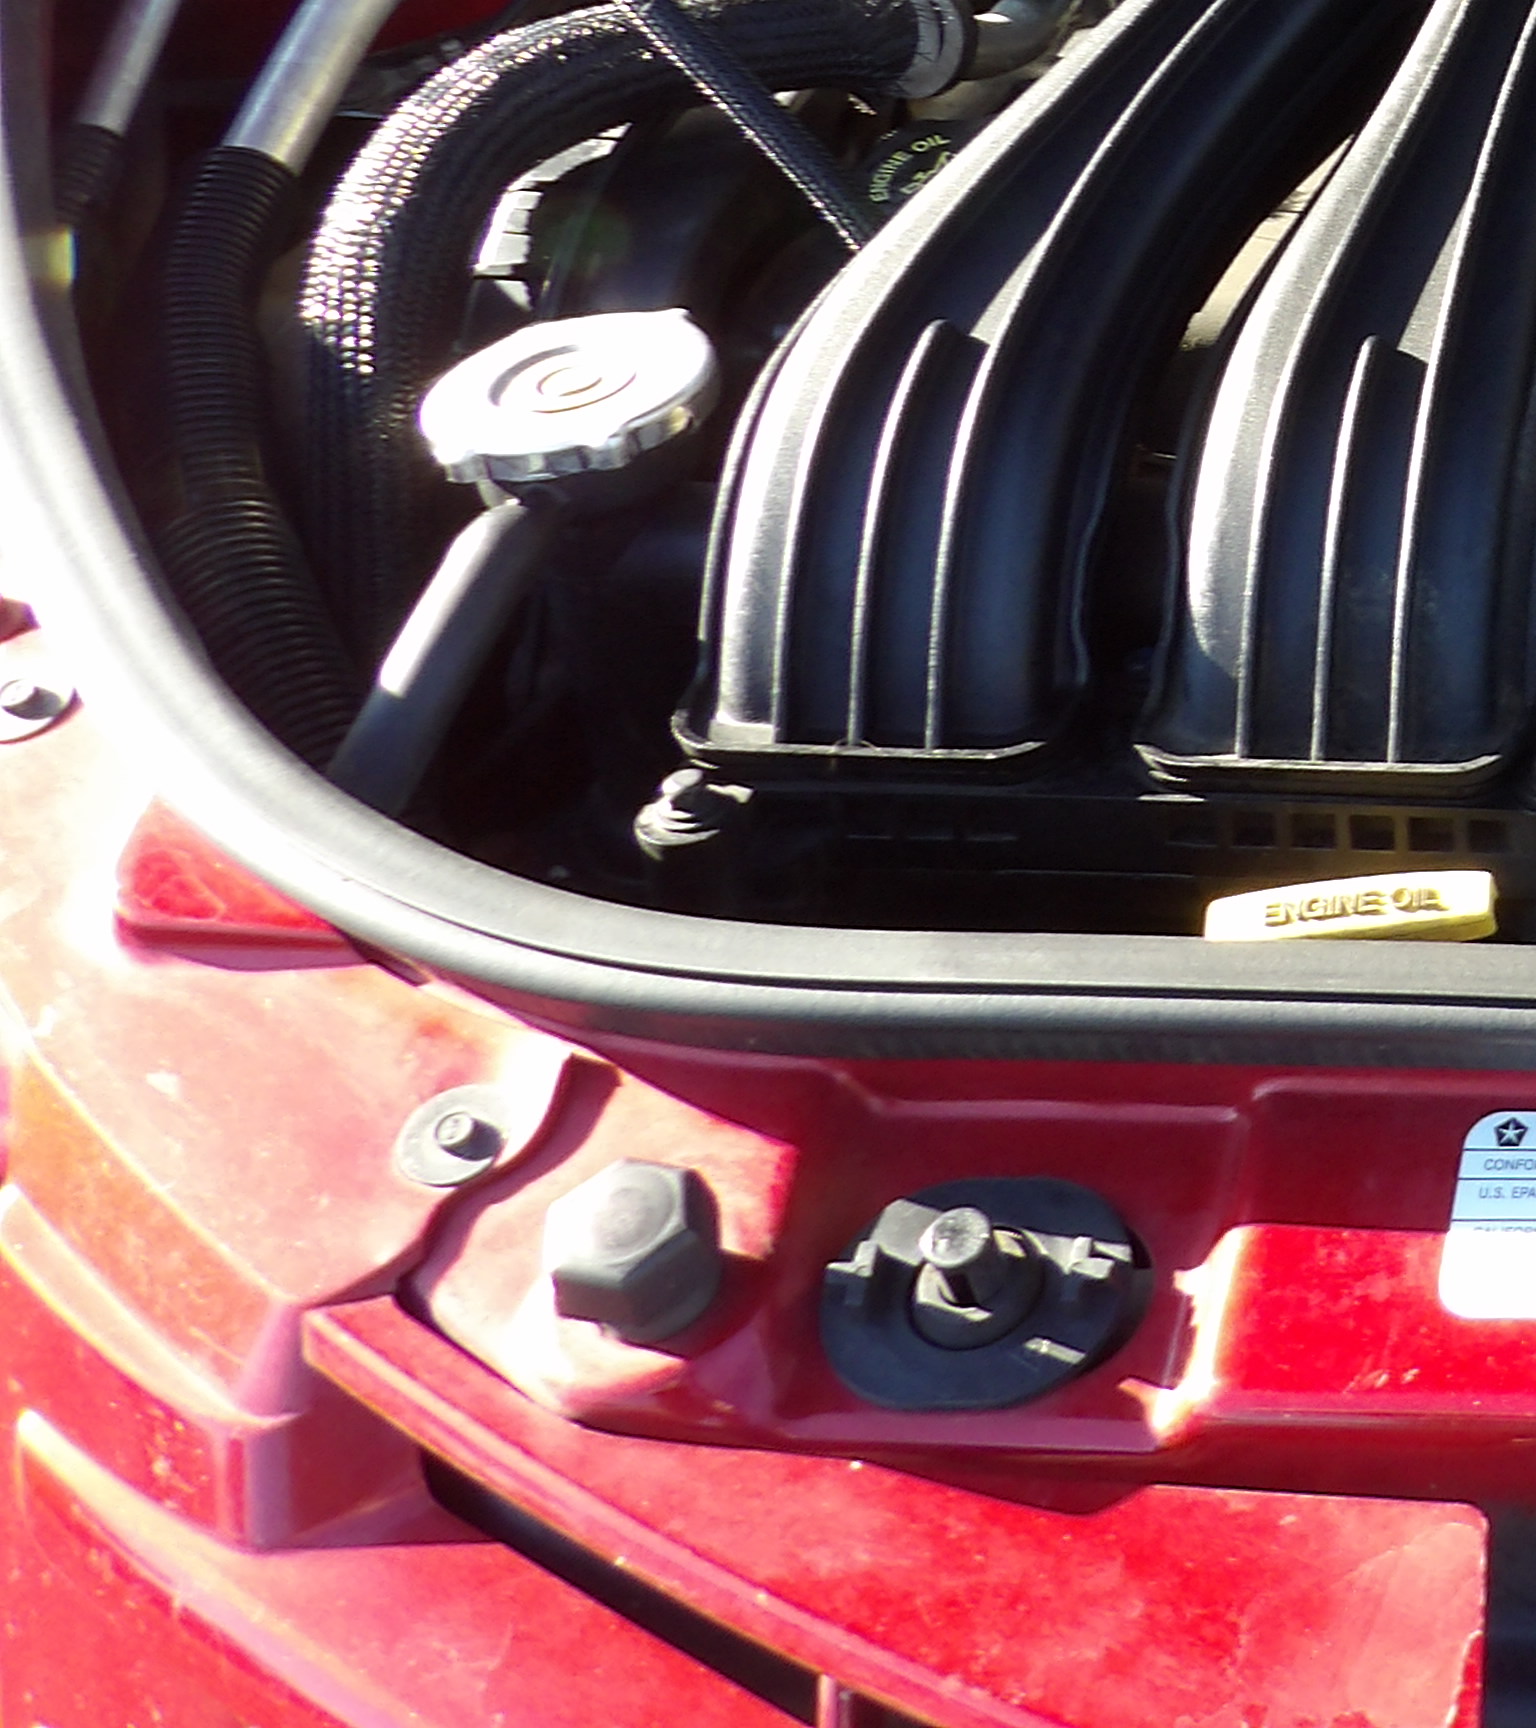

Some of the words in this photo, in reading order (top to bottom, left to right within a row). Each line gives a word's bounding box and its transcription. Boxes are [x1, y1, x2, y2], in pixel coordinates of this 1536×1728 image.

[868, 151, 914, 203] ENGINE
[911, 134, 953, 153] OIL
[1264, 890, 1388, 928] ENGINE
[1391, 887, 1451, 913] OIL
[1478, 1186, 1507, 1199] U.S.
